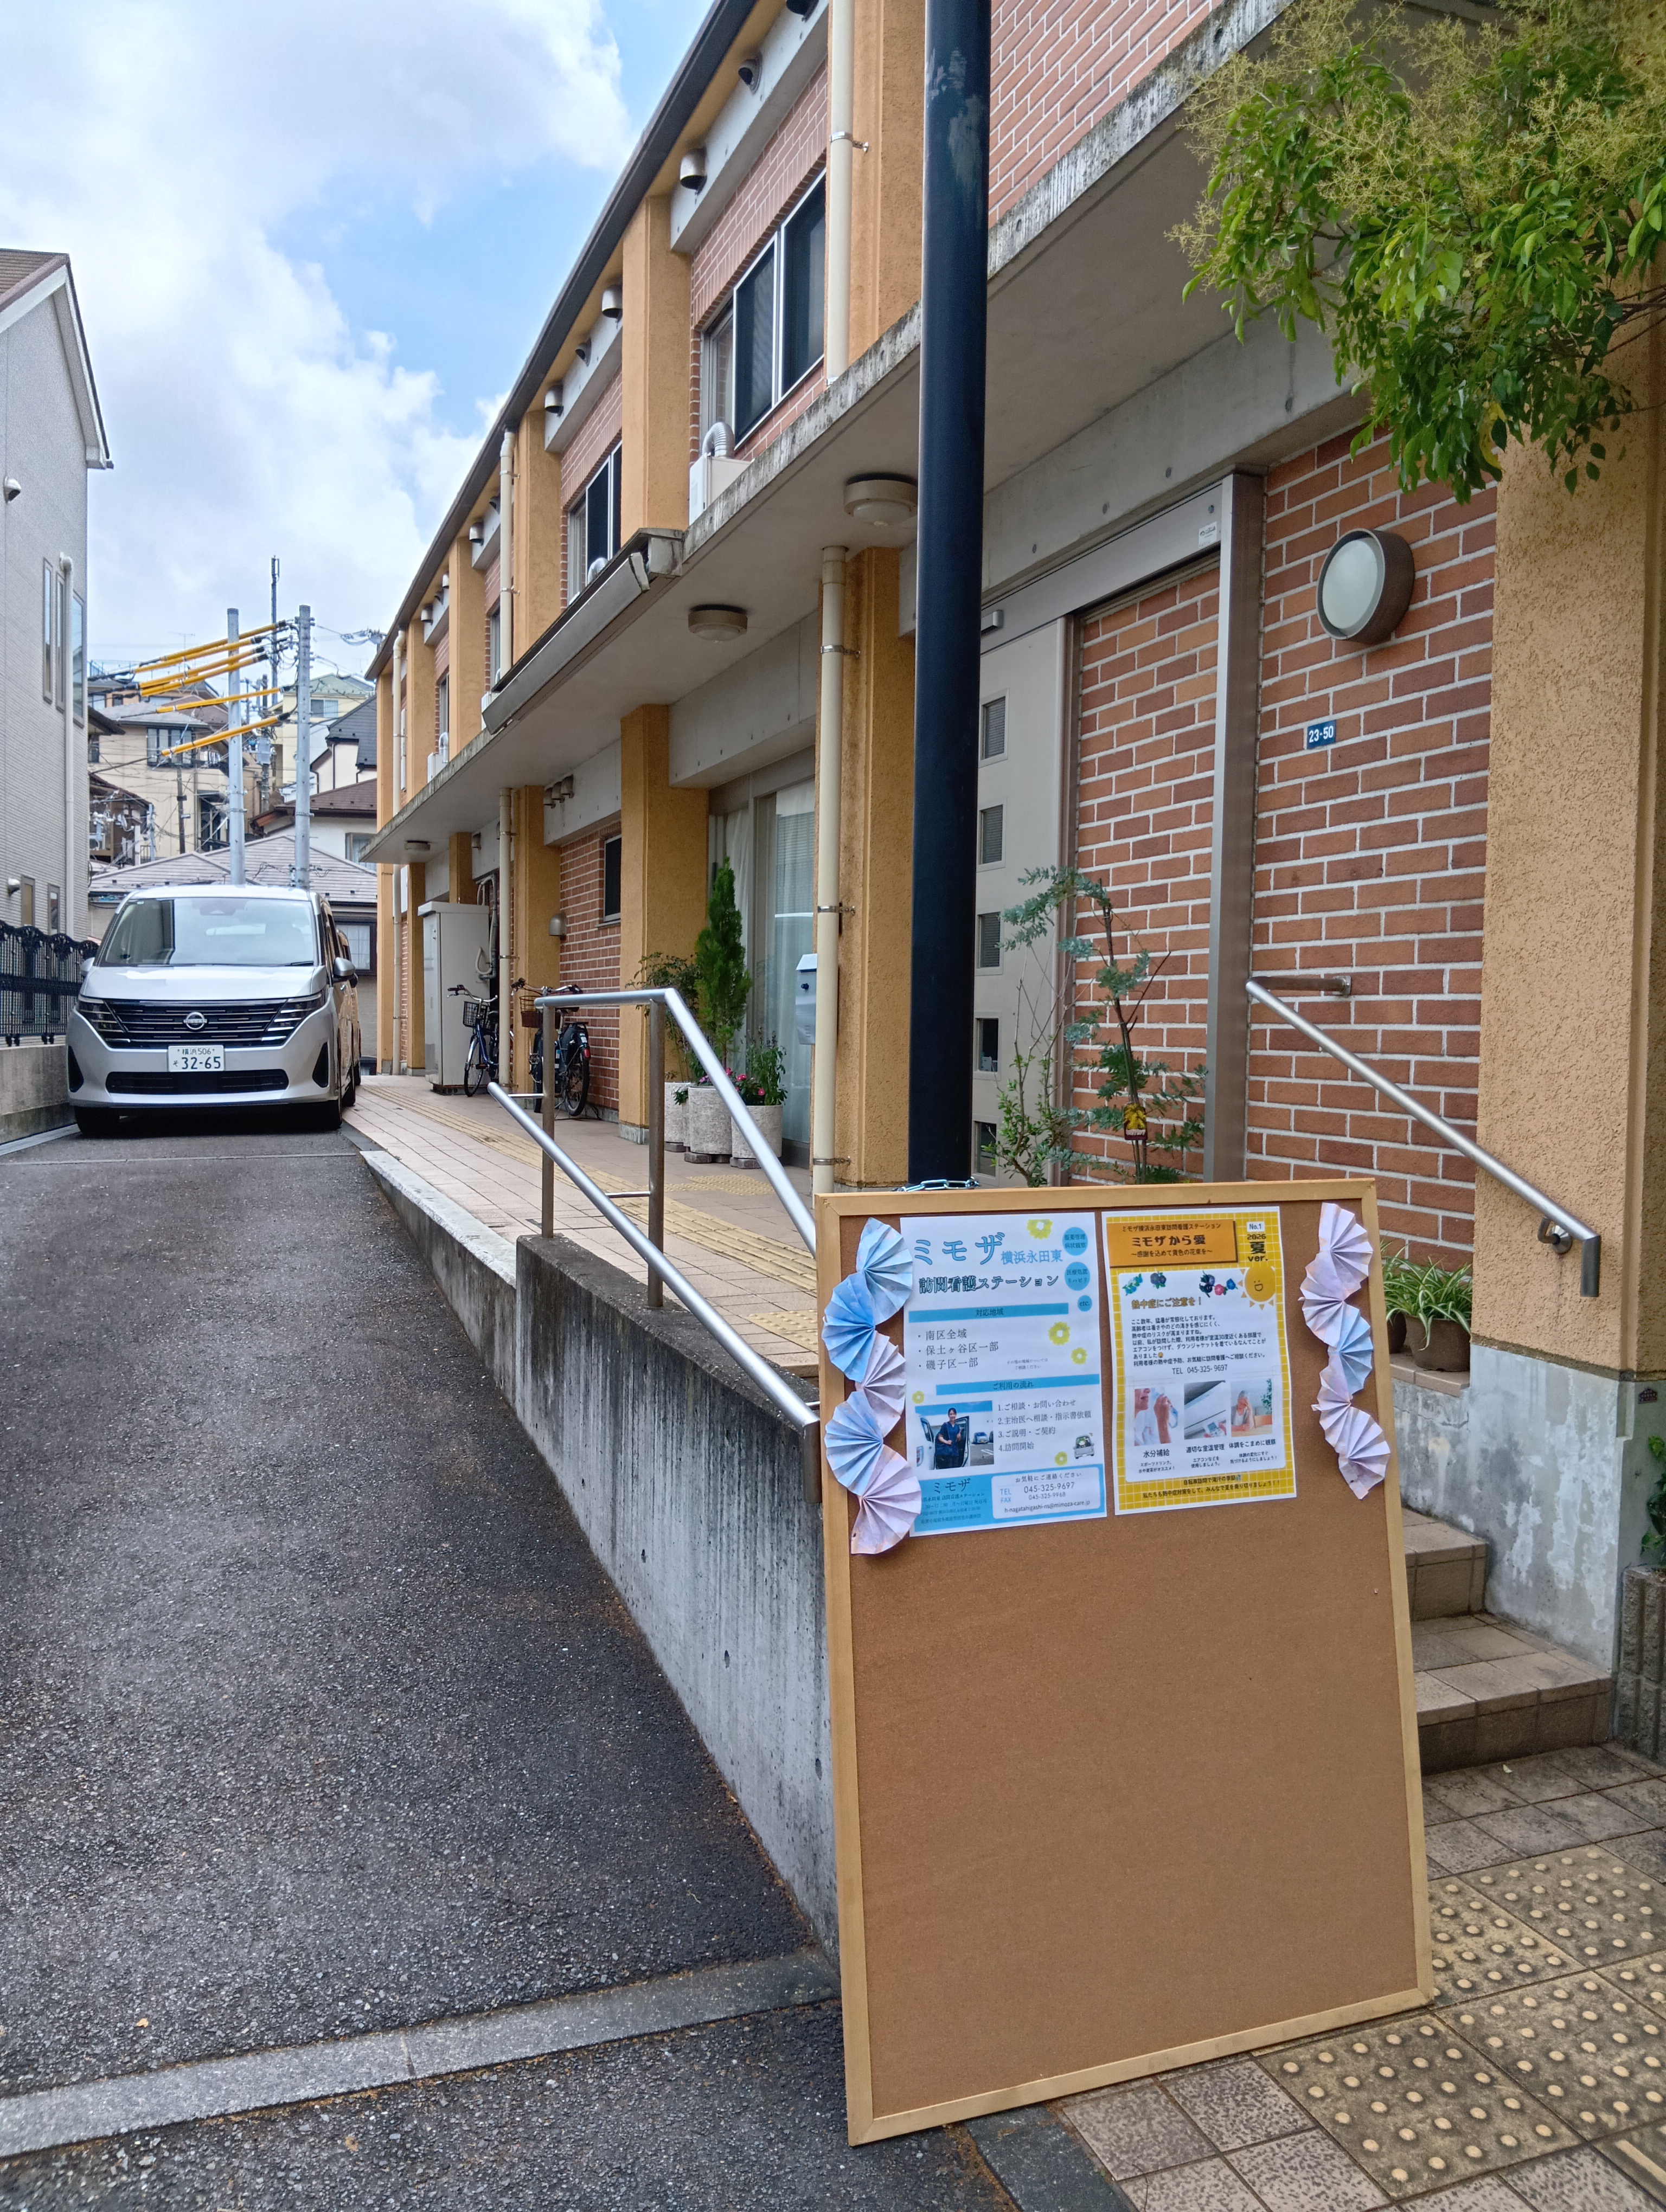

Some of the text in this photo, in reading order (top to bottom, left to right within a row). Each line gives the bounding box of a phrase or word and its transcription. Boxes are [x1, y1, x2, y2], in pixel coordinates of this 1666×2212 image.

[1309, 725, 1334, 743] 23-50
[182, 1056, 221, 1070] 32-65
[1122, 1223, 1221, 1232] ミモザ横浜永田東訪問看護ステーション
[1132, 1234, 1206, 1247] ミモザから愛
[914, 1232, 1063, 1265] ミモザ 横浜永田東
[1250, 1241, 1266, 1254] 夏
[919, 1275, 1059, 1294] 訪問看護ステーション
[976, 1308, 1003, 1317] 対応地域
[993, 1381, 1034, 1391] ご利用の流れ
[1186, 1444, 1225, 1453] 適切な室温管理
[1229, 1439, 1276, 1449] 体調をこまめに観察
[1143, 1449, 1170, 1458] 水分補給
[1016, 1472, 1082, 1483] お気軽にご連絡ください
[934, 1477, 971, 1494] ミモザ
[1024, 1482, 1075, 1493] 045-325-9697
